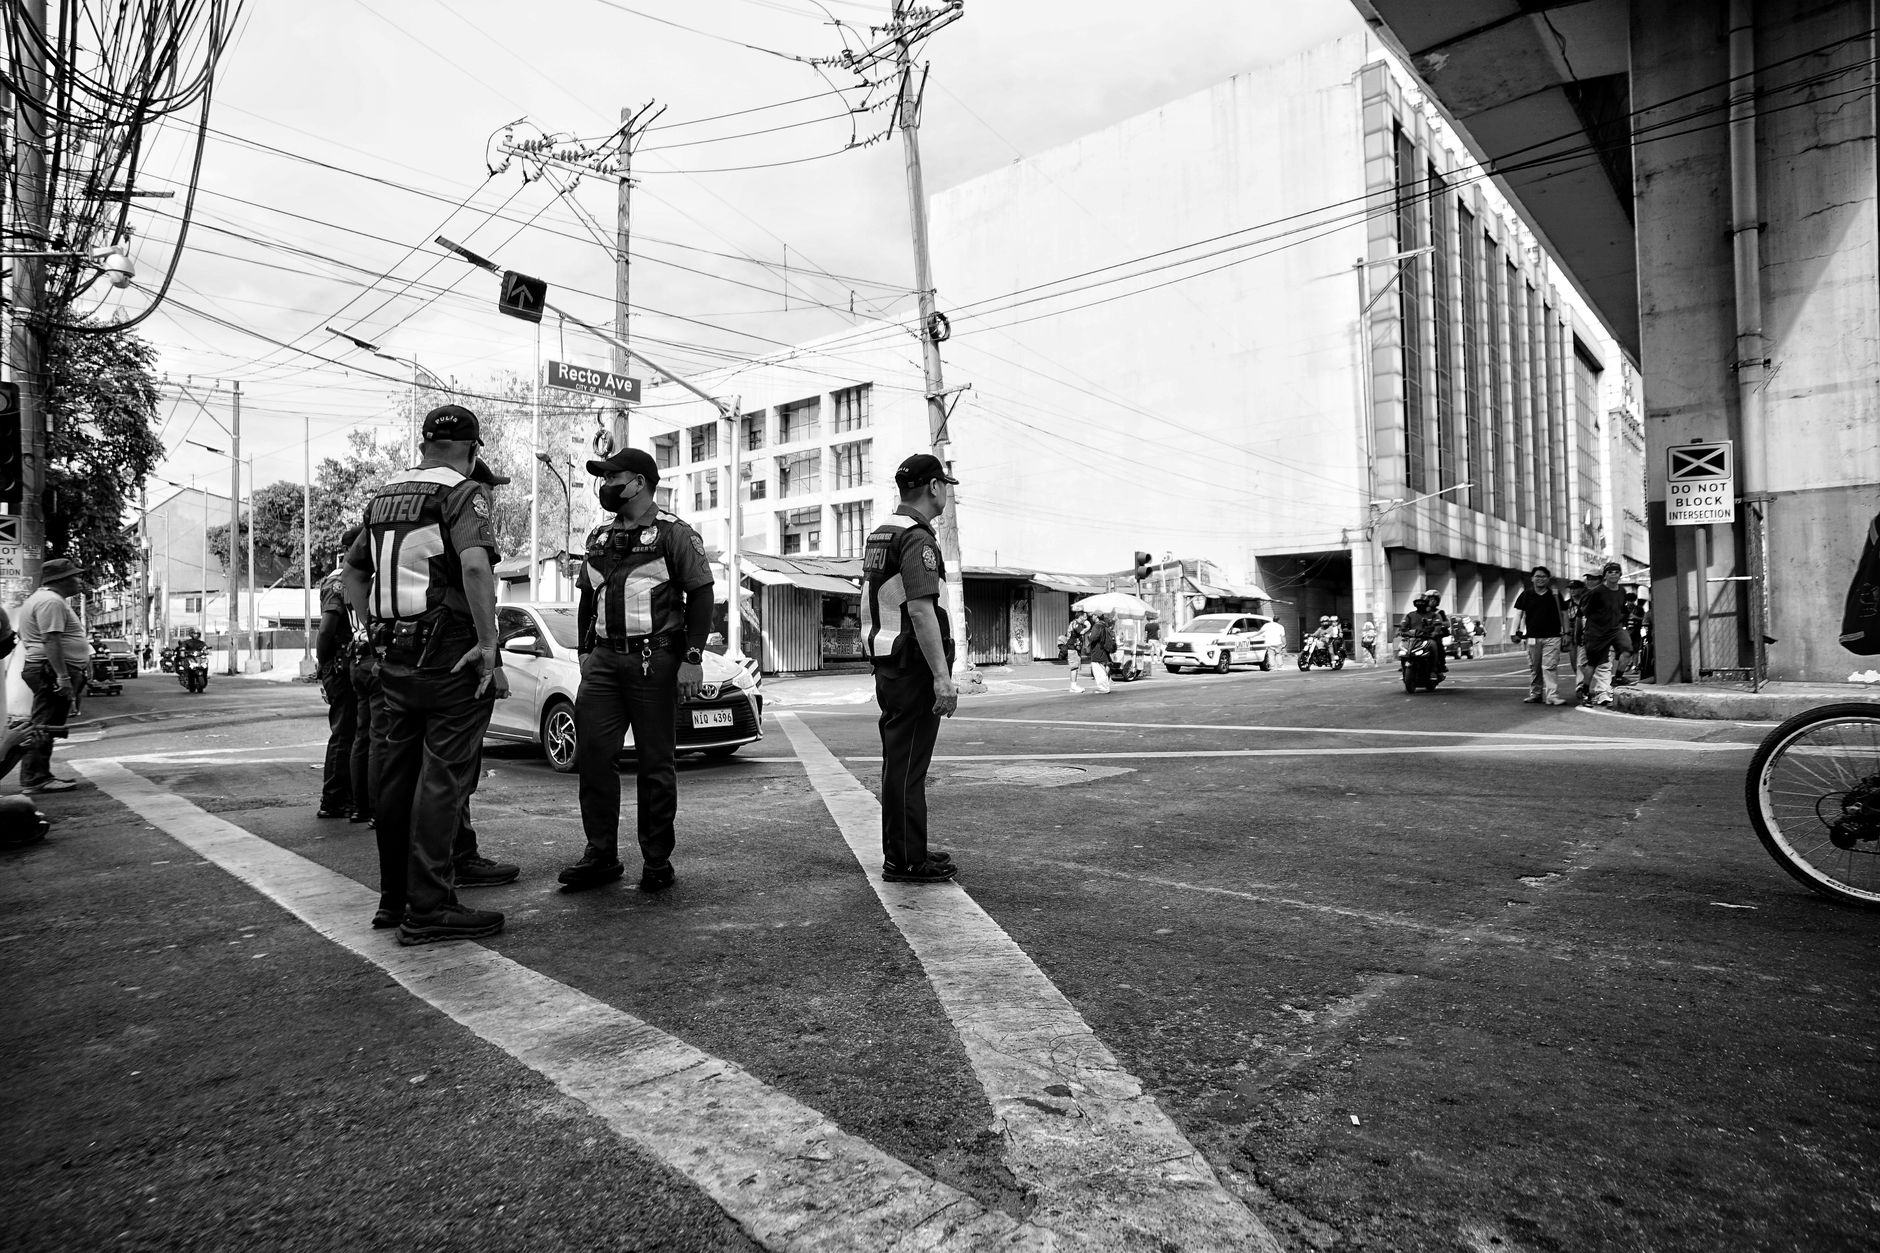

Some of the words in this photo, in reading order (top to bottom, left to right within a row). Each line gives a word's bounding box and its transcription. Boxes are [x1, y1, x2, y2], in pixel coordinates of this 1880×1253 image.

[559, 362, 601, 386] Recto
[605, 373, 633, 392] Ave
[575, 383, 588, 392] CITY
[598, 387, 617, 398] MANILA
[1671, 484, 1691, 495] DO
[1698, 482, 1728, 492] NOT
[1675, 496, 1723, 507] BLOCK
[1668, 508, 1732, 521] INTERSECTION
[1, 547, 18, 555] OT
[693, 714, 709, 725] NIQ
[713, 712, 732, 723] 4396
